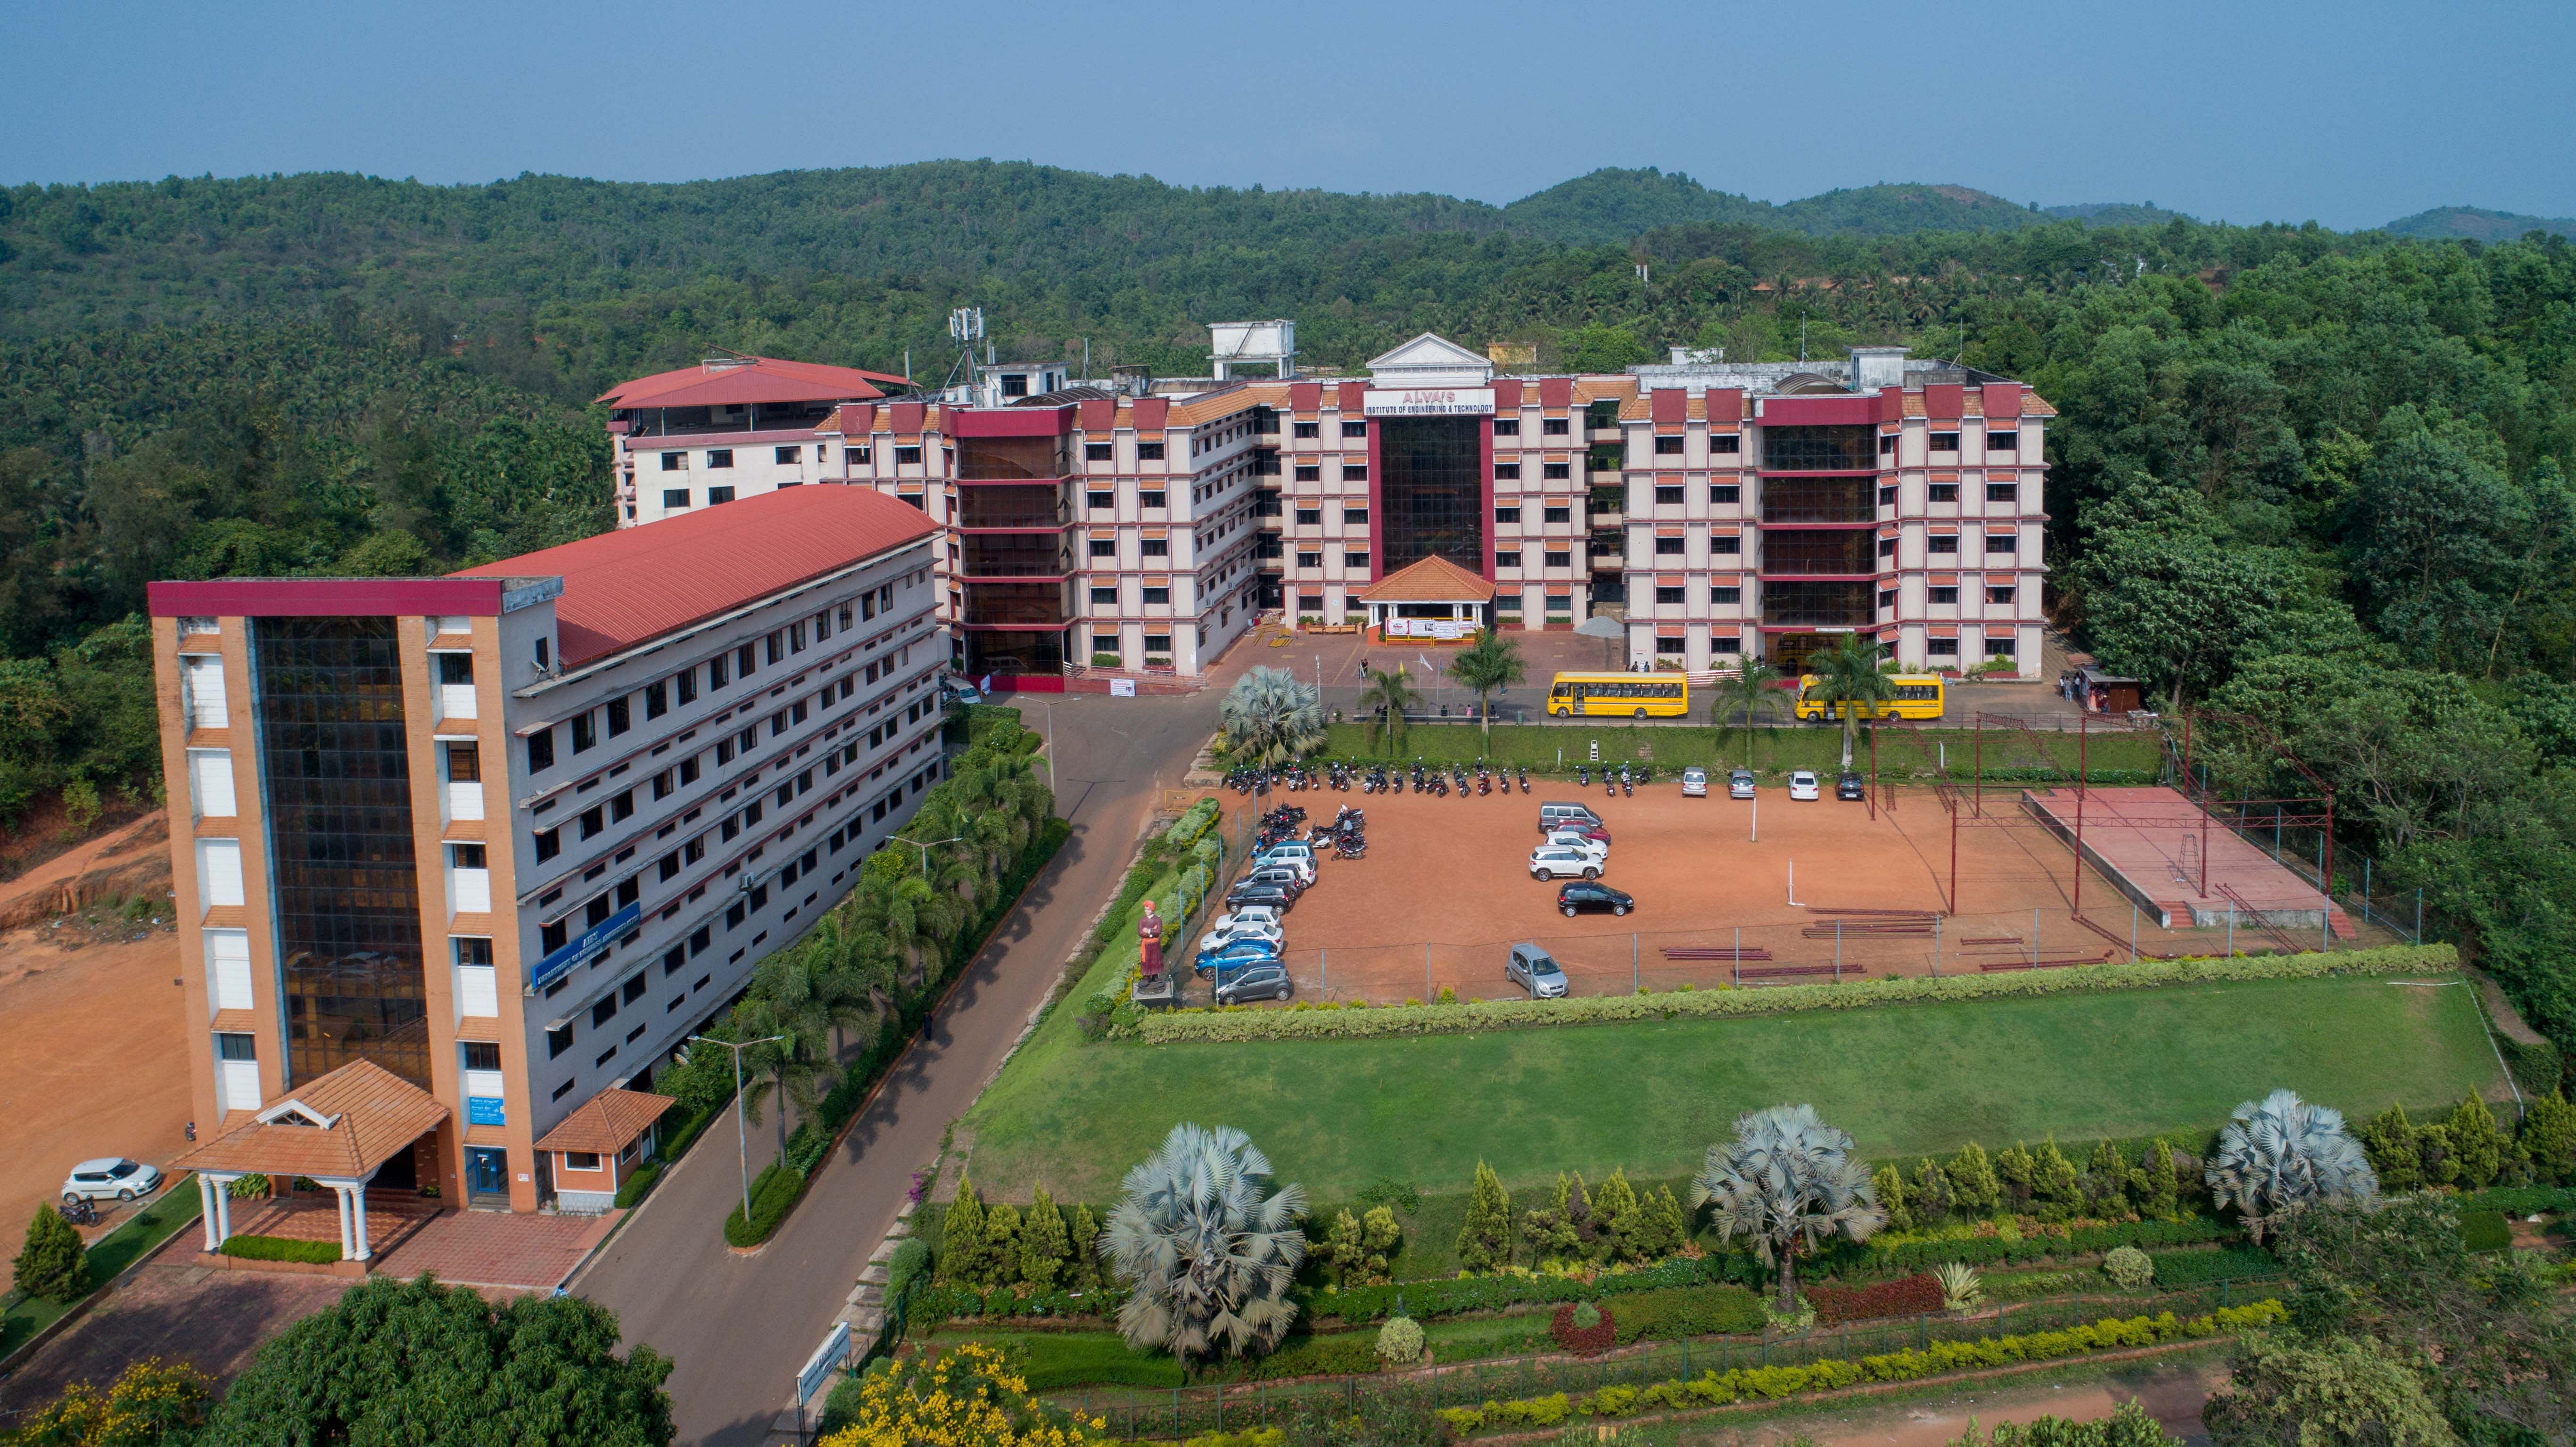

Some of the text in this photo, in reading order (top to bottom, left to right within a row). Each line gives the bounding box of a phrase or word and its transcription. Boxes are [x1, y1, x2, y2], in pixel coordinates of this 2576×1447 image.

[1403, 391, 1455, 403] ALVA'S
[1366, 406, 1396, 414] INSTITUTE
[1408, 405, 1446, 413] ENGINEERING
[1454, 404, 1493, 413] TECHNOLOGY
